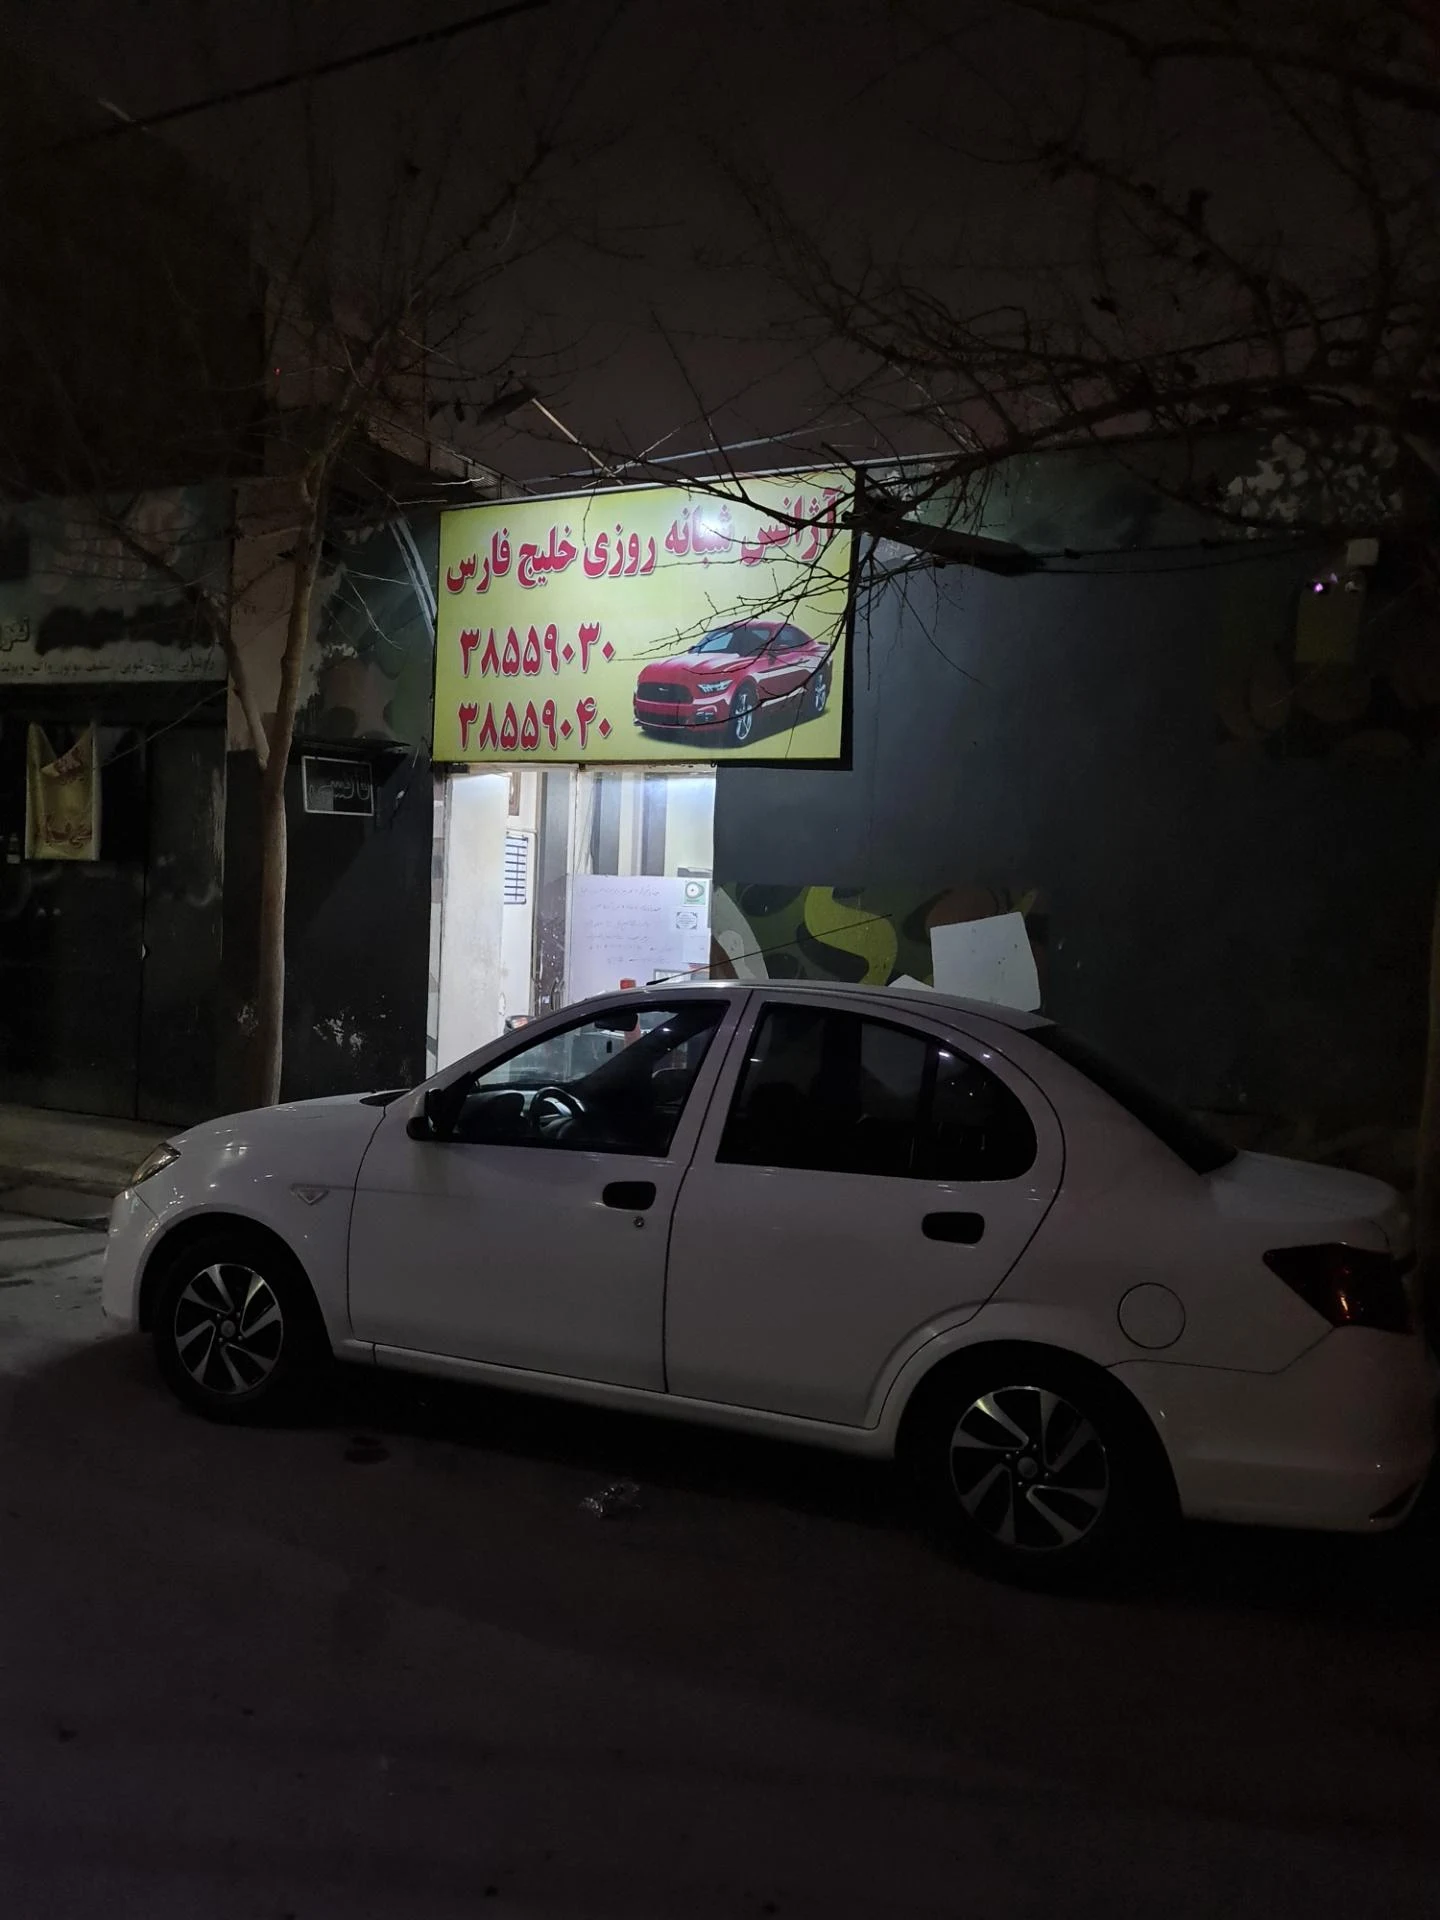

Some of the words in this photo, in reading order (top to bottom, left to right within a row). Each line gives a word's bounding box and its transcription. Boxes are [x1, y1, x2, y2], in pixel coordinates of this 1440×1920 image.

[583, 524, 656, 577] روزی
[665, 504, 734, 568] شبانه
[741, 485, 844, 566] آژانس
[447, 528, 510, 593] فارس
[517, 527, 577, 587] خلیج
[460, 622, 615, 677] ۳۸۵۵۹۰۳۰
[457, 696, 613, 751] ۳۸۵۵۹۰۴۰
